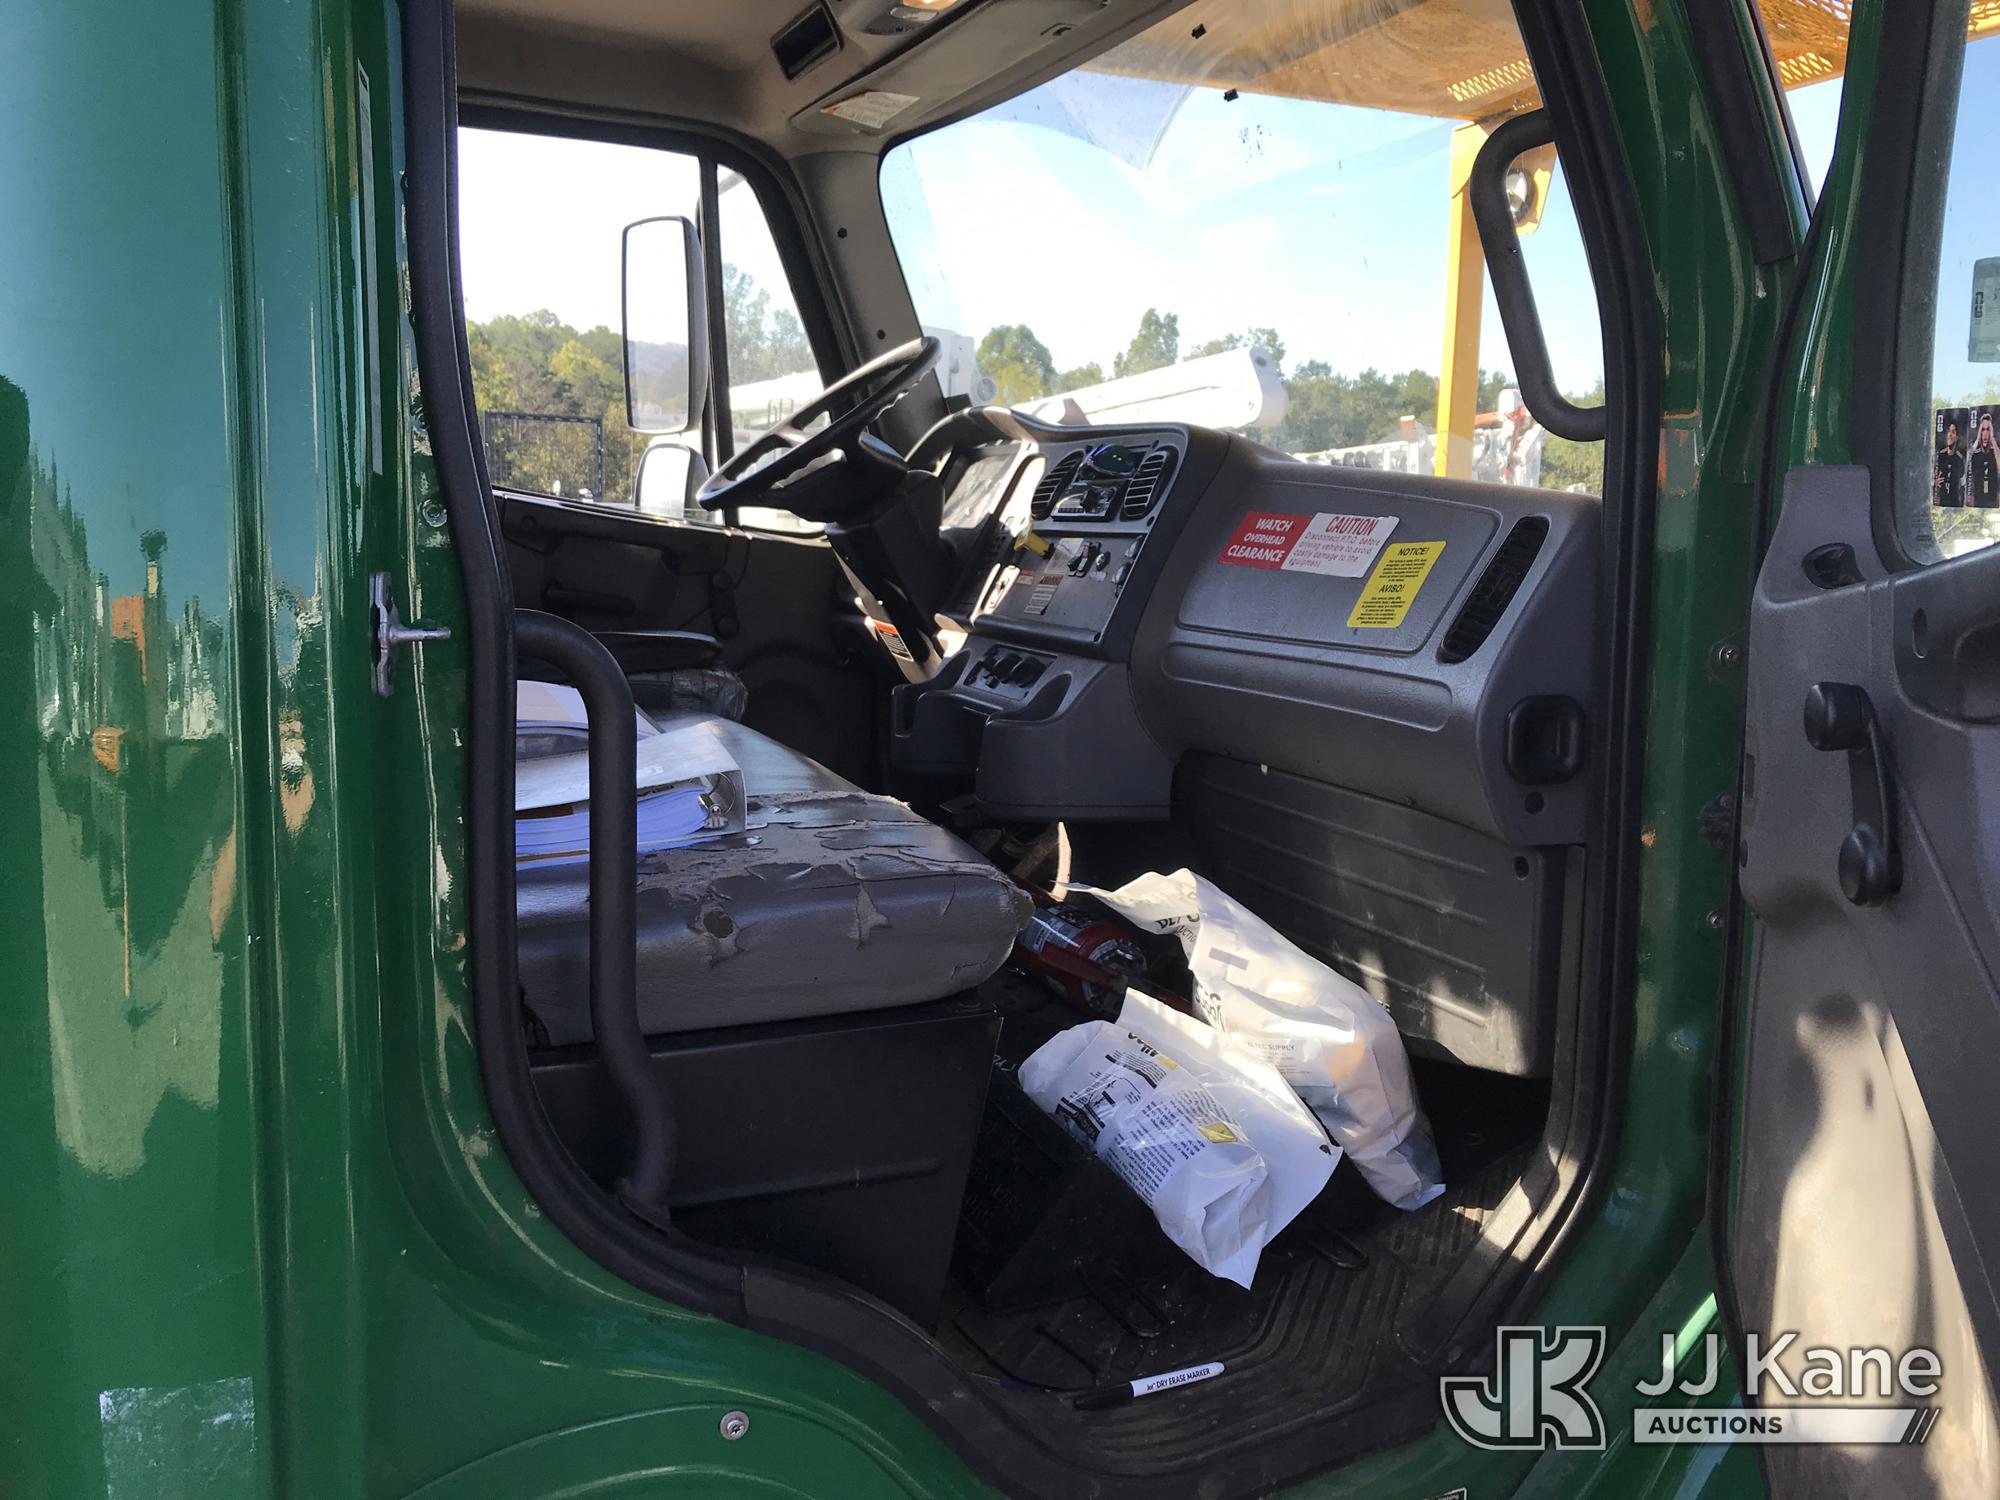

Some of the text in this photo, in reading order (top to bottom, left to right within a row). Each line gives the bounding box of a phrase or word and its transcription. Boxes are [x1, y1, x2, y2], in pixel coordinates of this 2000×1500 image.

[1255, 518, 1294, 532] WATCH
[1325, 516, 1379, 536] CAUTION
[1243, 533, 1286, 545] OVERHEAD
[1359, 538, 1381, 546] before
[1227, 545, 1285, 562] CLEARANCE
[1398, 547, 1430, 556] NOTICE!
[1379, 584, 1406, 593] AVISO!
[1156, 1380, 1168, 1388] DRY
[1168, 1374, 1186, 1385] ERASE
[1186, 1368, 1211, 1380] MARKER
